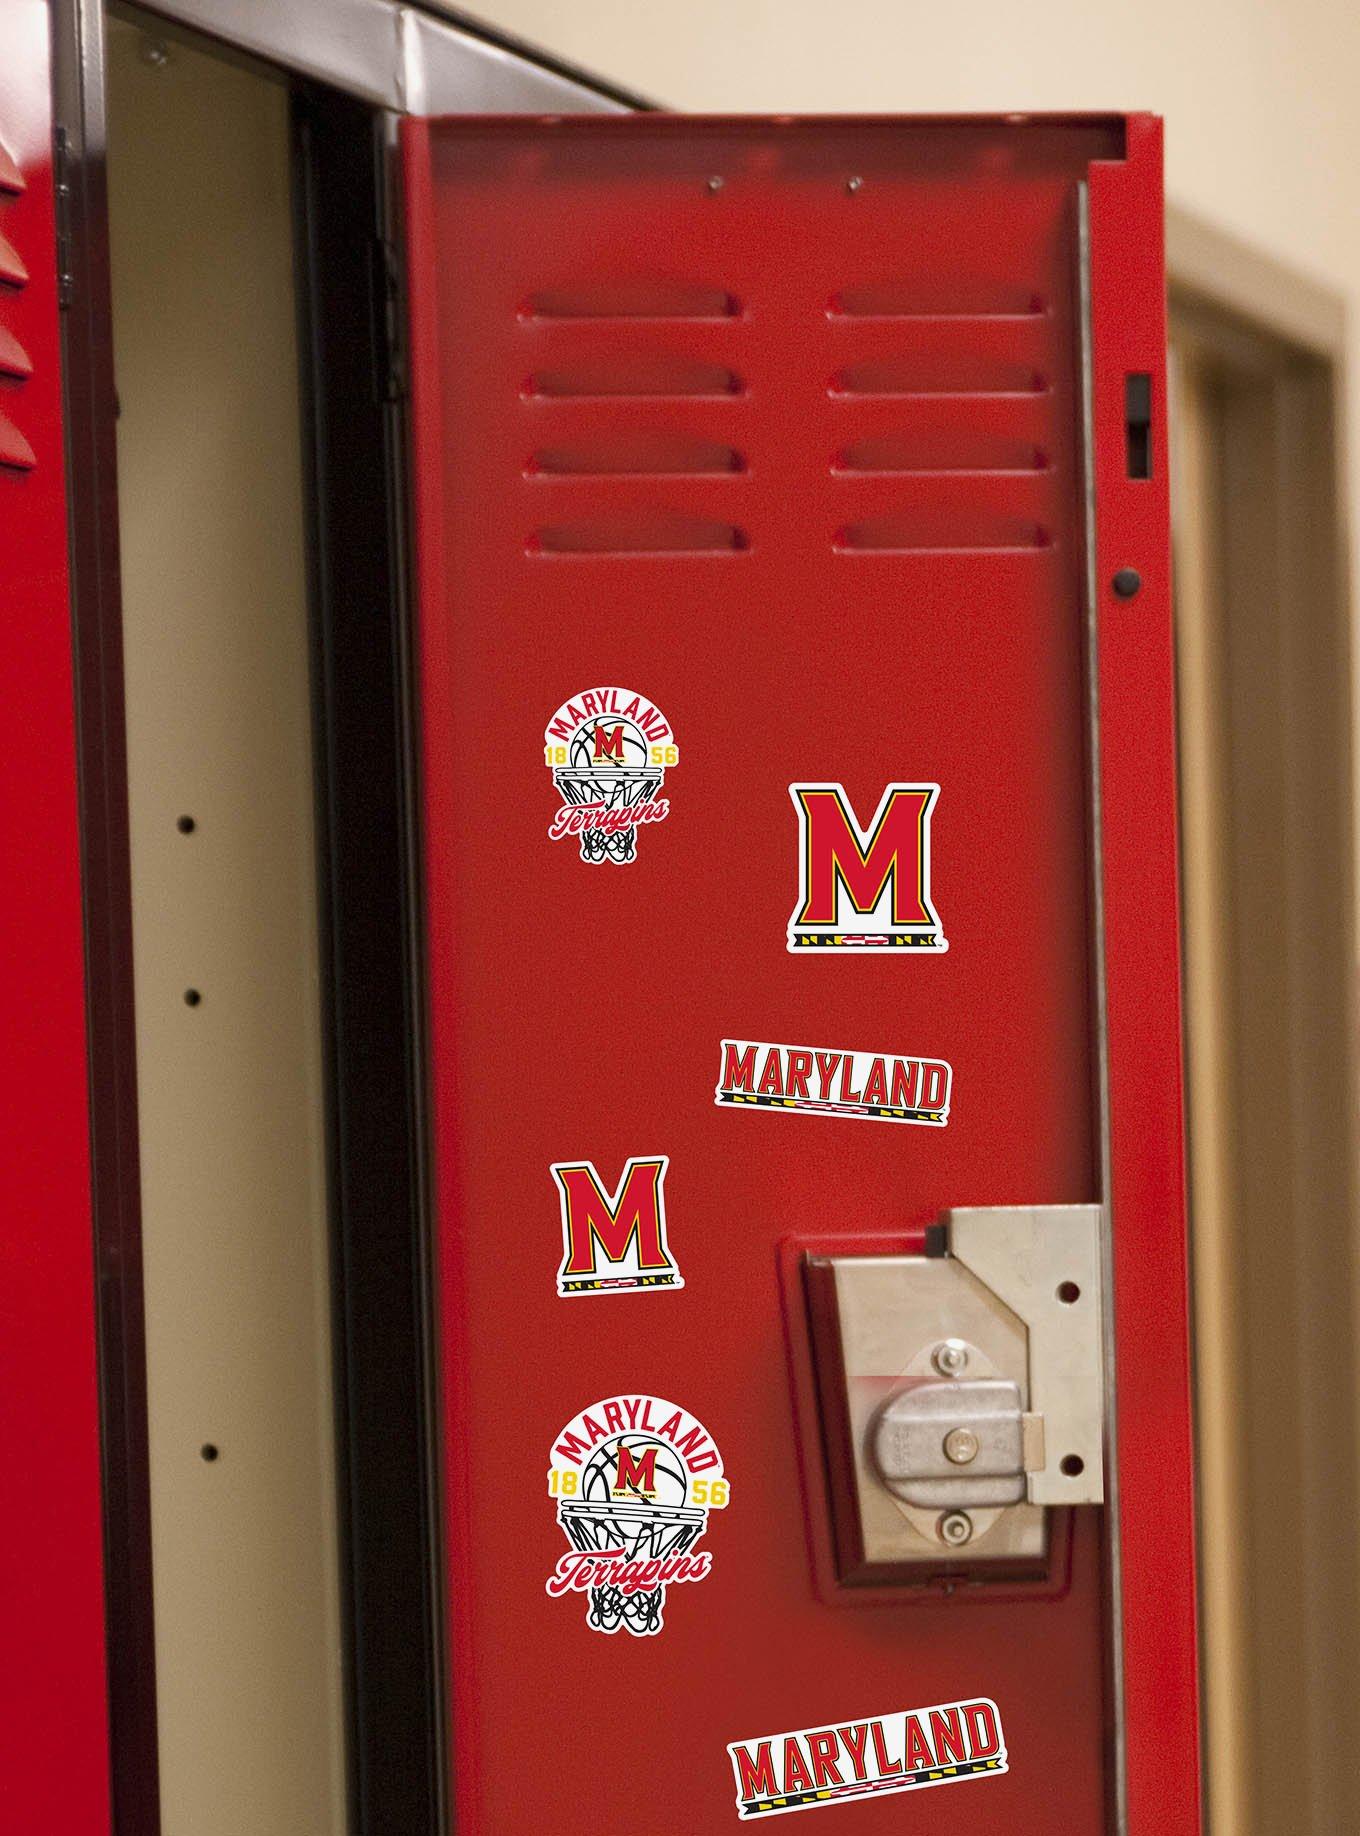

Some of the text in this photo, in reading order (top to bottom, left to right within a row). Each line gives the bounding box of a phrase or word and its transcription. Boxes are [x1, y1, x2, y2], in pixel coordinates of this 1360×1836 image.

[548, 690, 669, 742] MARYLAND
[546, 747, 677, 764] 18 56
[593, 725, 625, 758] M
[551, 799, 666, 837] Terrapins
[795, 789, 936, 926] M
[720, 1043, 949, 1111] MARYLAND
[555, 1161, 673, 1276] M
[555, 1399, 718, 1473] MARYLAND
[551, 1470, 727, 1505] 18 56
[615, 1446, 658, 1491] M
[550, 1547, 707, 1594] Terrapins
[732, 1702, 1000, 1801] MARYLAND
